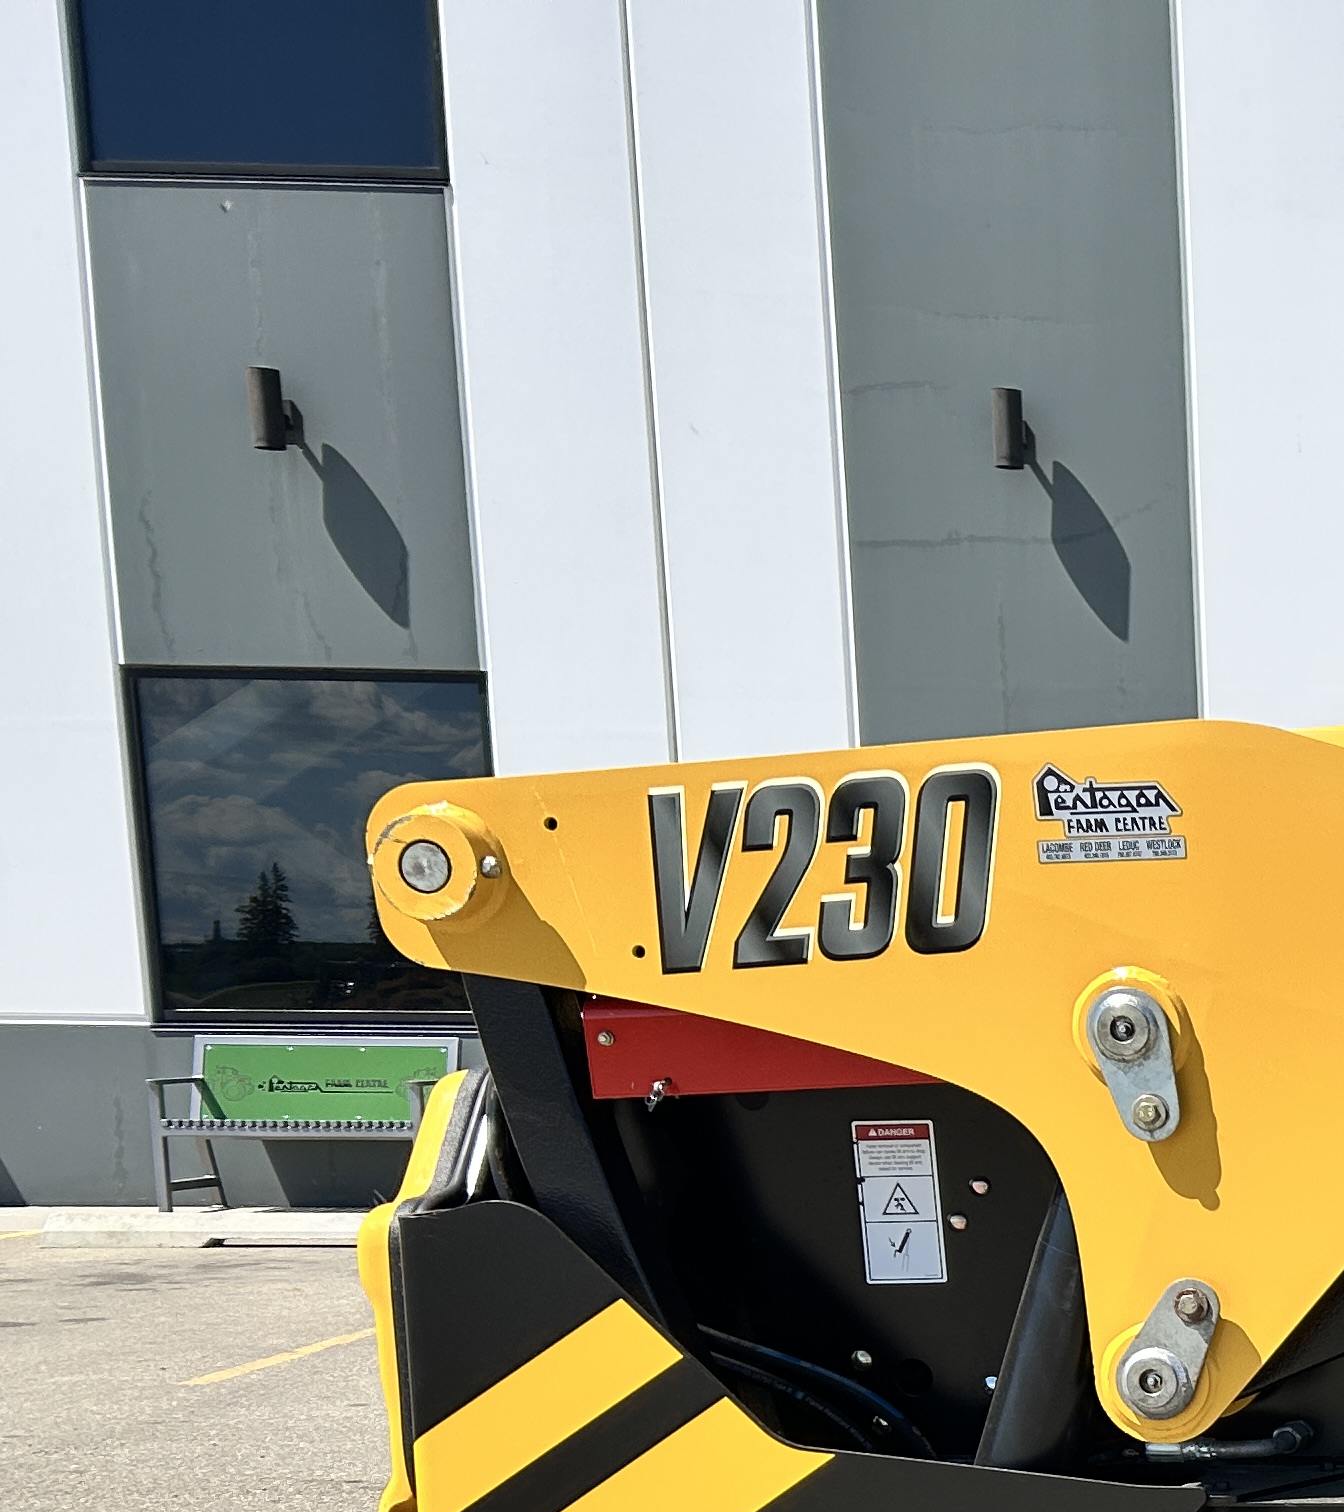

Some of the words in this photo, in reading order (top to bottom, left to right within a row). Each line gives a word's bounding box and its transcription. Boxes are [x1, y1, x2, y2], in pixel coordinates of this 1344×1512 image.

[1036, 767, 1179, 816] Pentagon
[1067, 818, 1109, 834] FARM
[1115, 816, 1168, 832] CENTRE
[1042, 842, 1074, 854] LACOMBE
[1080, 841, 1093, 852] RED
[1118, 839, 1140, 851] LEDUC
[1146, 838, 1182, 851] WESTLOCK
[648, 762, 1001, 975] V230
[878, 1127, 915, 1137] DANGER
